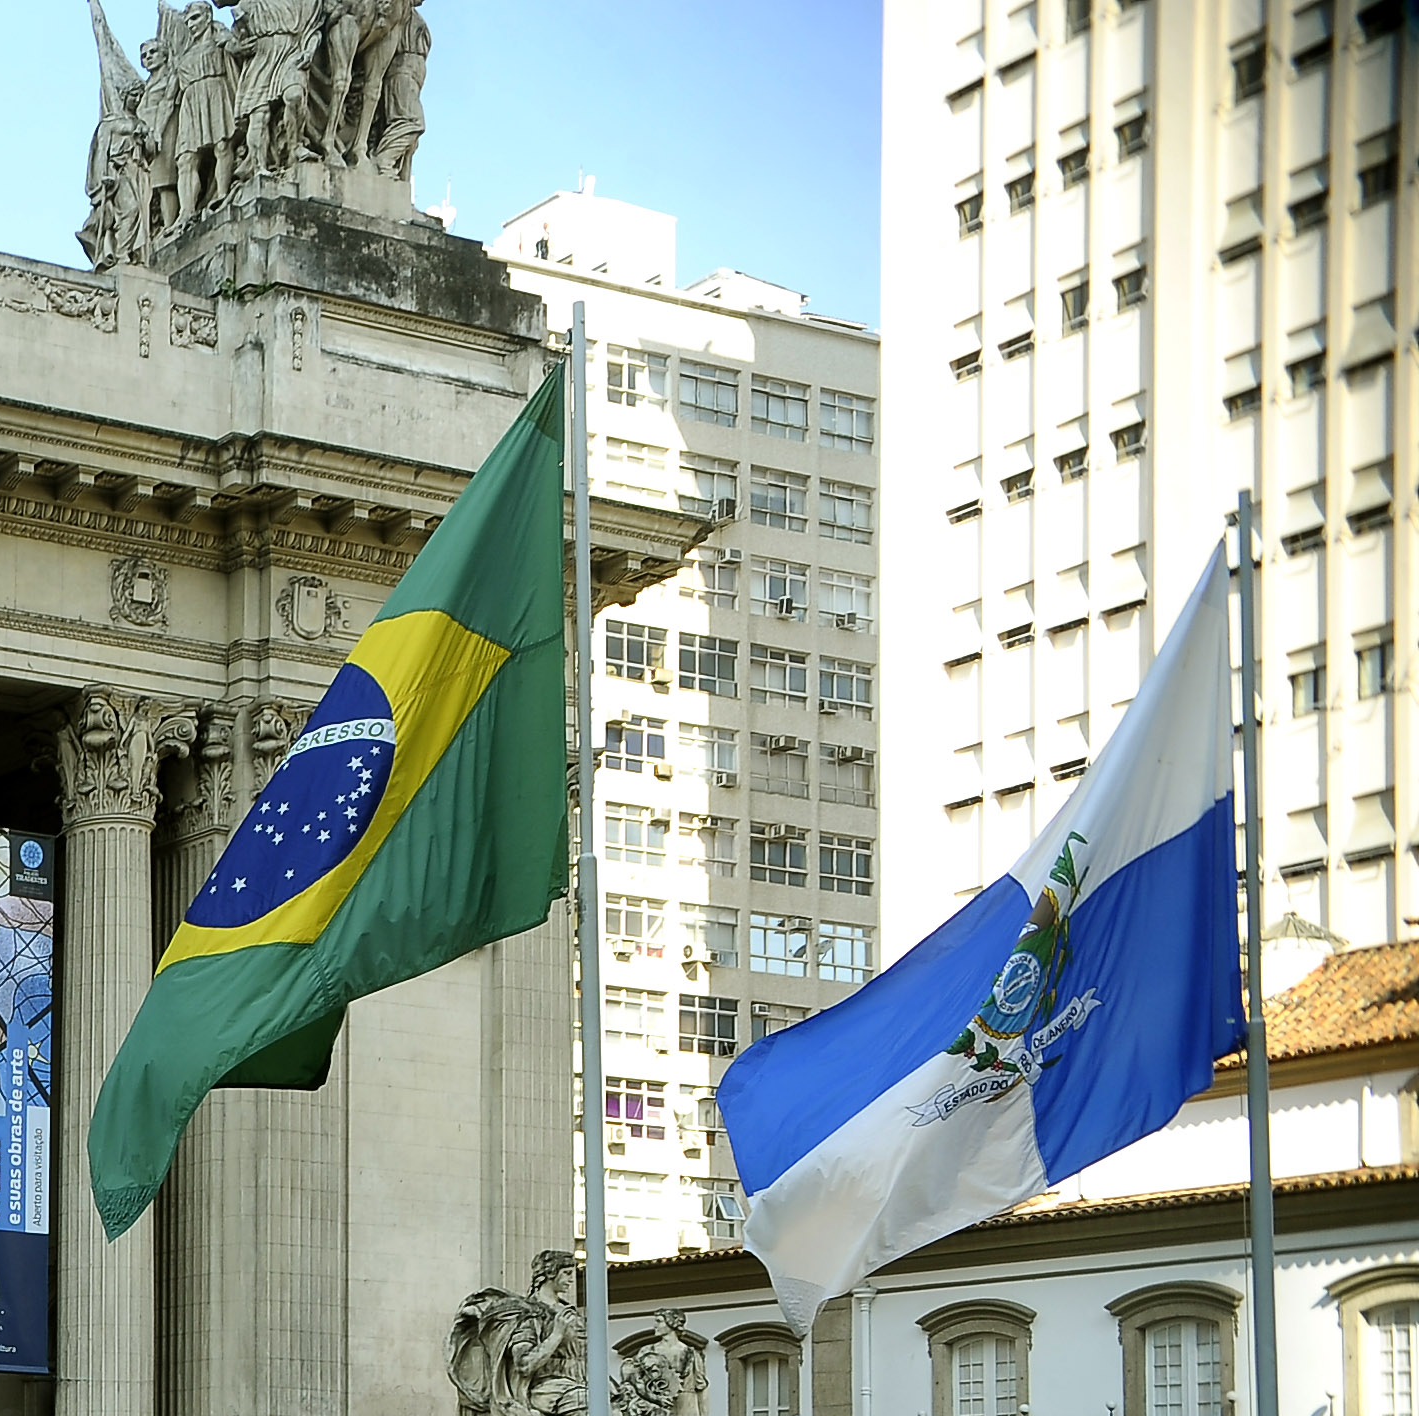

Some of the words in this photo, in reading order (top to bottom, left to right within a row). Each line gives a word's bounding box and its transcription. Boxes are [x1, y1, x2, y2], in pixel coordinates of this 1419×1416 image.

[293, 721, 385, 751] GRESSO
[11, 1048, 24, 1087] arte
[9, 1089, 23, 1113] de
[943, 1082, 988, 1112] ESTADO
[990, 1079, 1009, 1091] DO
[8, 1115, 23, 1166] obras
[33, 1128, 44, 1168] visitação
[10, 1169, 22, 1211] suas
[33, 1169, 44, 1191] para
[9, 1214, 22, 1225] e
[32, 1192, 42, 1226] Aberto
